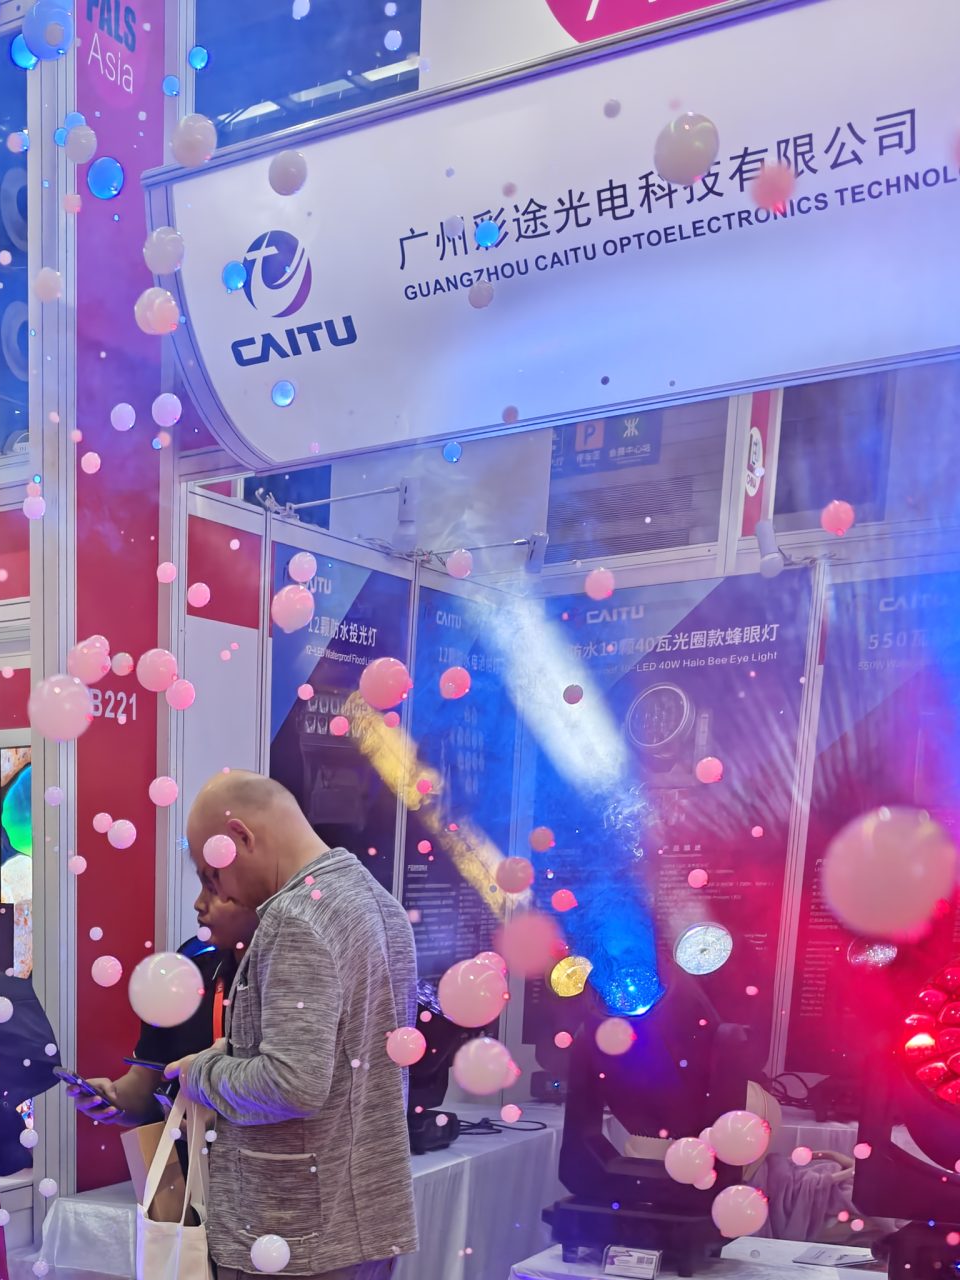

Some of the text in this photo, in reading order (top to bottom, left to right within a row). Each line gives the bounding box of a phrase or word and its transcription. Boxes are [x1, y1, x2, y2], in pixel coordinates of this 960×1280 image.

[87, 32, 134, 94] Asia
[404, 165, 960, 301] GUANGZHOU CAITU OPTOELECTRONICS TECHNOL
[230, 314, 358, 367] CAITU
[436, 610, 462, 629] CAITU
[586, 605, 645, 624] CAITU
[658, 658, 681, 670] 40W
[682, 656, 706, 668] Halo
[707, 656, 728, 666] Bee
[729, 653, 749, 667] Eye
[751, 651, 778, 664] Light
